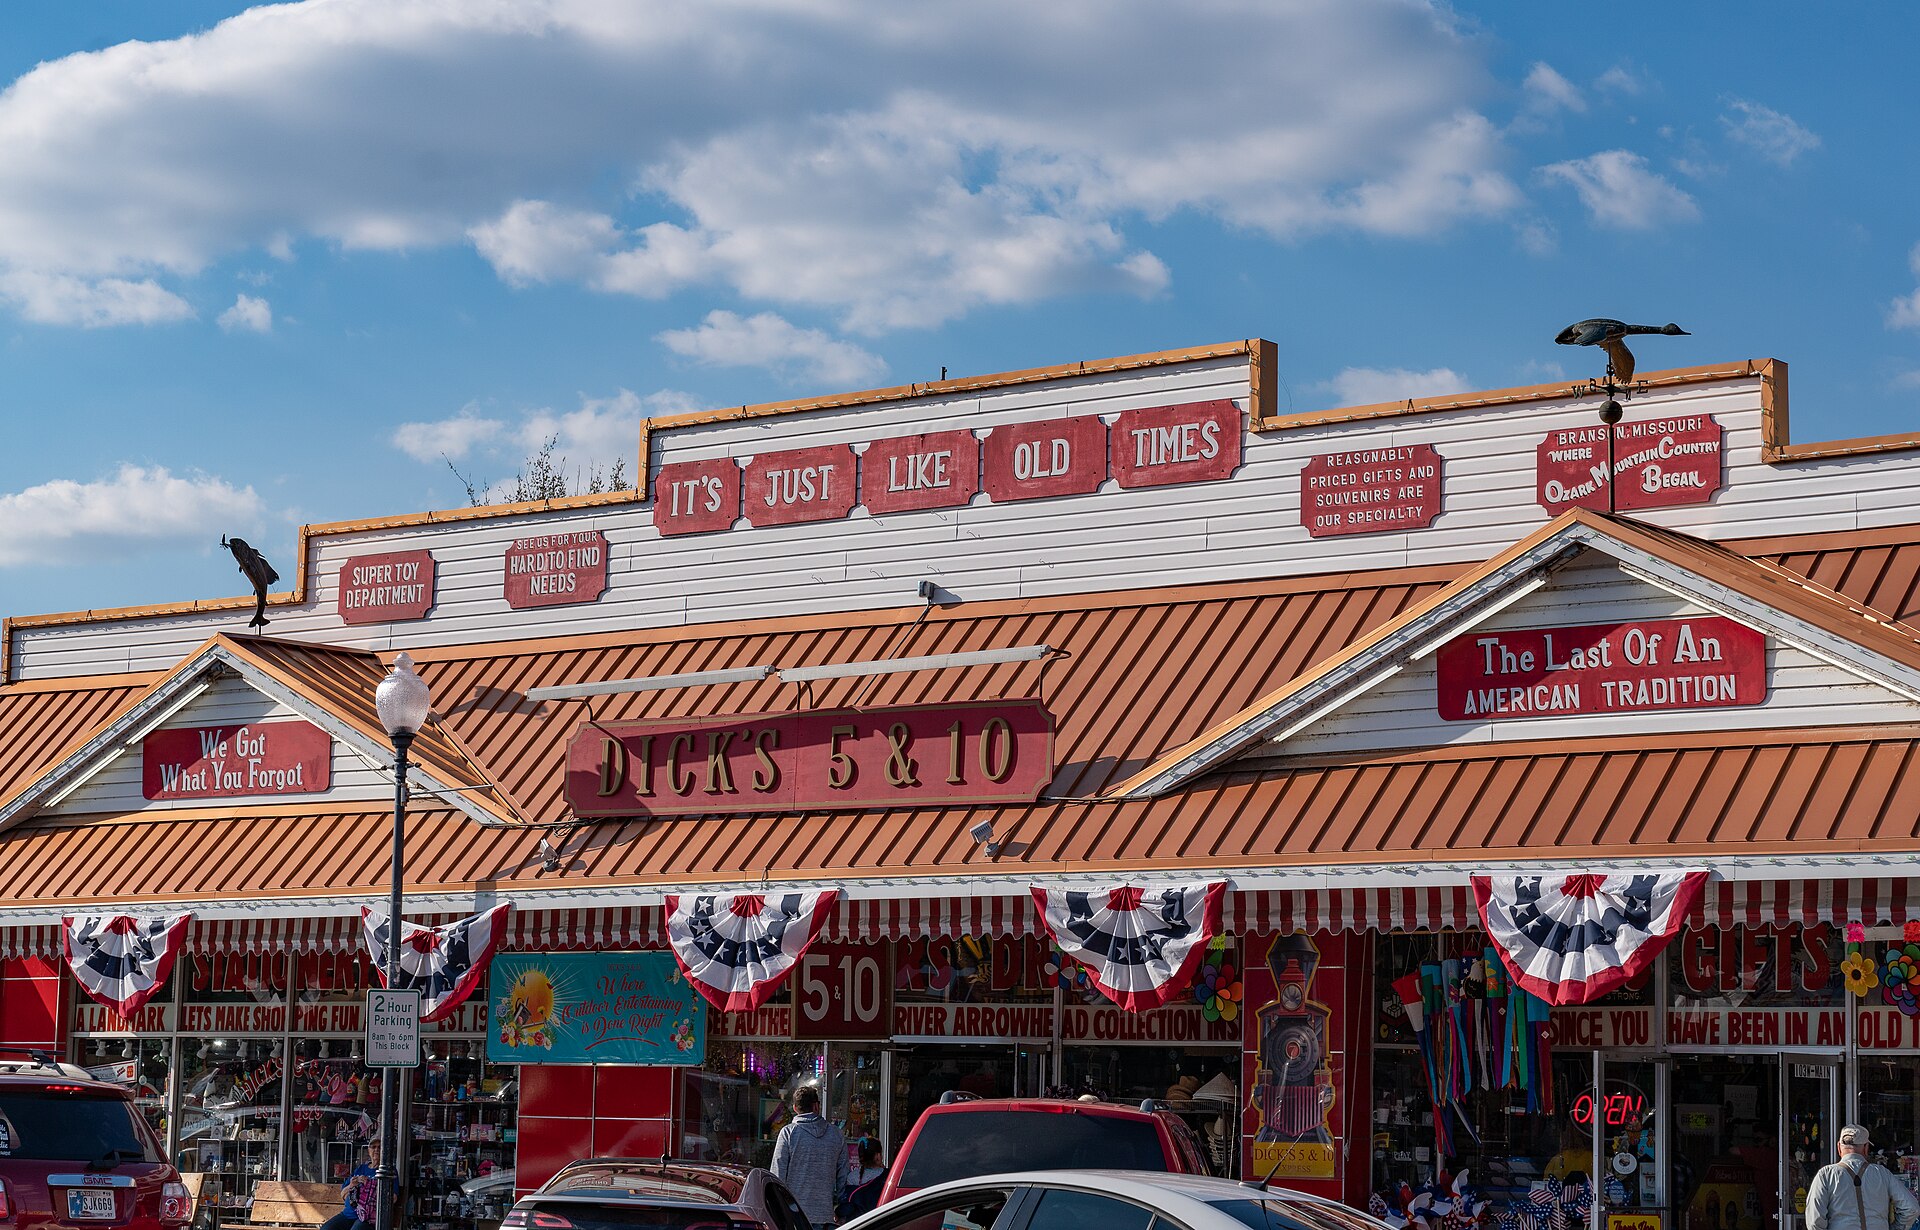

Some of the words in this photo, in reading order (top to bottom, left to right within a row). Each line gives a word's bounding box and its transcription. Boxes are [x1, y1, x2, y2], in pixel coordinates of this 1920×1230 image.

[1557, 427, 1630, 445] BRANSN,
[1632, 418, 1703, 437] MISSOURI
[1327, 448, 1415, 467] REASONABLY
[1548, 447, 1593, 463] WHERE
[670, 475, 723, 516] IT'S
[764, 465, 834, 507] JUST
[888, 450, 952, 492] LIKE
[1014, 439, 1070, 480] OLD
[1131, 420, 1221, 467] TIMES
[1309, 474, 1357, 489] PRICED
[1363, 468, 1402, 484] GIFTS
[1408, 465, 1435, 479] AND
[1316, 488, 1391, 507] SOUVENIRS
[1398, 485, 1424, 500] ARE
[1316, 515, 1342, 528] OUR
[1348, 505, 1424, 525] SPECIALTY
[517, 538, 535, 550] SEE
[535, 537, 548, 548] US
[551, 534, 570, 547] FOR
[572, 532, 598, 545] YOUR
[510, 552, 546, 575] HARD
[547, 550, 565, 570] TO
[567, 547, 601, 569] FIND
[352, 564, 392, 586] SUPER
[395, 562, 420, 582] TOY
[529, 574, 577, 596] NEEDS
[346, 584, 425, 608] DEPARTMENT
[1477, 637, 1535, 676] The
[1543, 633, 1613, 672] Last
[1623, 627, 1662, 665] Of
[1672, 623, 1723, 664] An
[1464, 683, 1580, 716] AMERICAN
[1601, 673, 1736, 707] TRADITION
[199, 729, 228, 759] We
[236, 727, 266, 758] Got
[596, 727, 780, 798] DICK'S
[827, 724, 857, 790] 5
[885, 721, 922, 788] &
[944, 716, 1013, 784] 10
[160, 763, 207, 793] What
[211, 761, 242, 791] You
[248, 758, 303, 791] Forgot
[1681, 924, 1831, 993] GIFTS
[597, 973, 647, 996] Where
[802, 954, 830, 1022] 5
[834, 985, 841, 1000] &
[837, 955, 880, 1023] 10
[374, 995, 385, 1012] 2
[388, 1001, 412, 1013] Hour
[561, 1000, 610, 1024] Outdoor
[614, 995, 684, 1016] Entertaining
[75, 1007, 85, 1032] A
[181, 1005, 211, 1032] LETS
[215, 1006, 250, 1032] MAKE
[331, 1006, 360, 1032] FUN
[374, 1015, 411, 1029] Parking
[581, 1021, 590, 1035] is
[594, 1016, 625, 1040] Done
[628, 1012, 667, 1035] Right
[895, 1006, 947, 1036] RIVER
[1093, 1009, 1202, 1041] COLLECTION
[1549, 1011, 1603, 1046] SINCE
[1610, 1010, 1649, 1045] YOU
[1668, 1012, 1720, 1045] HAVE
[1727, 1012, 1779, 1045] BEEN
[1785, 1012, 1808, 1045] IN
[1816, 1012, 1845, 1045] AN
[1858, 1012, 1902, 1048] OLD
[375, 1042, 388, 1050] This
[390, 1042, 410, 1050] Block
[398, 1033, 414, 1042] 6pm
[1254, 1148, 1296, 1161] DICK'S
[1299, 1149, 1305, 1161] 5
[1308, 1149, 1318, 1161] &
[1322, 1150, 1334, 1162] 10
[83, 1177, 113, 1185] GMC
[83, 1197, 113, 1211] SJK669
